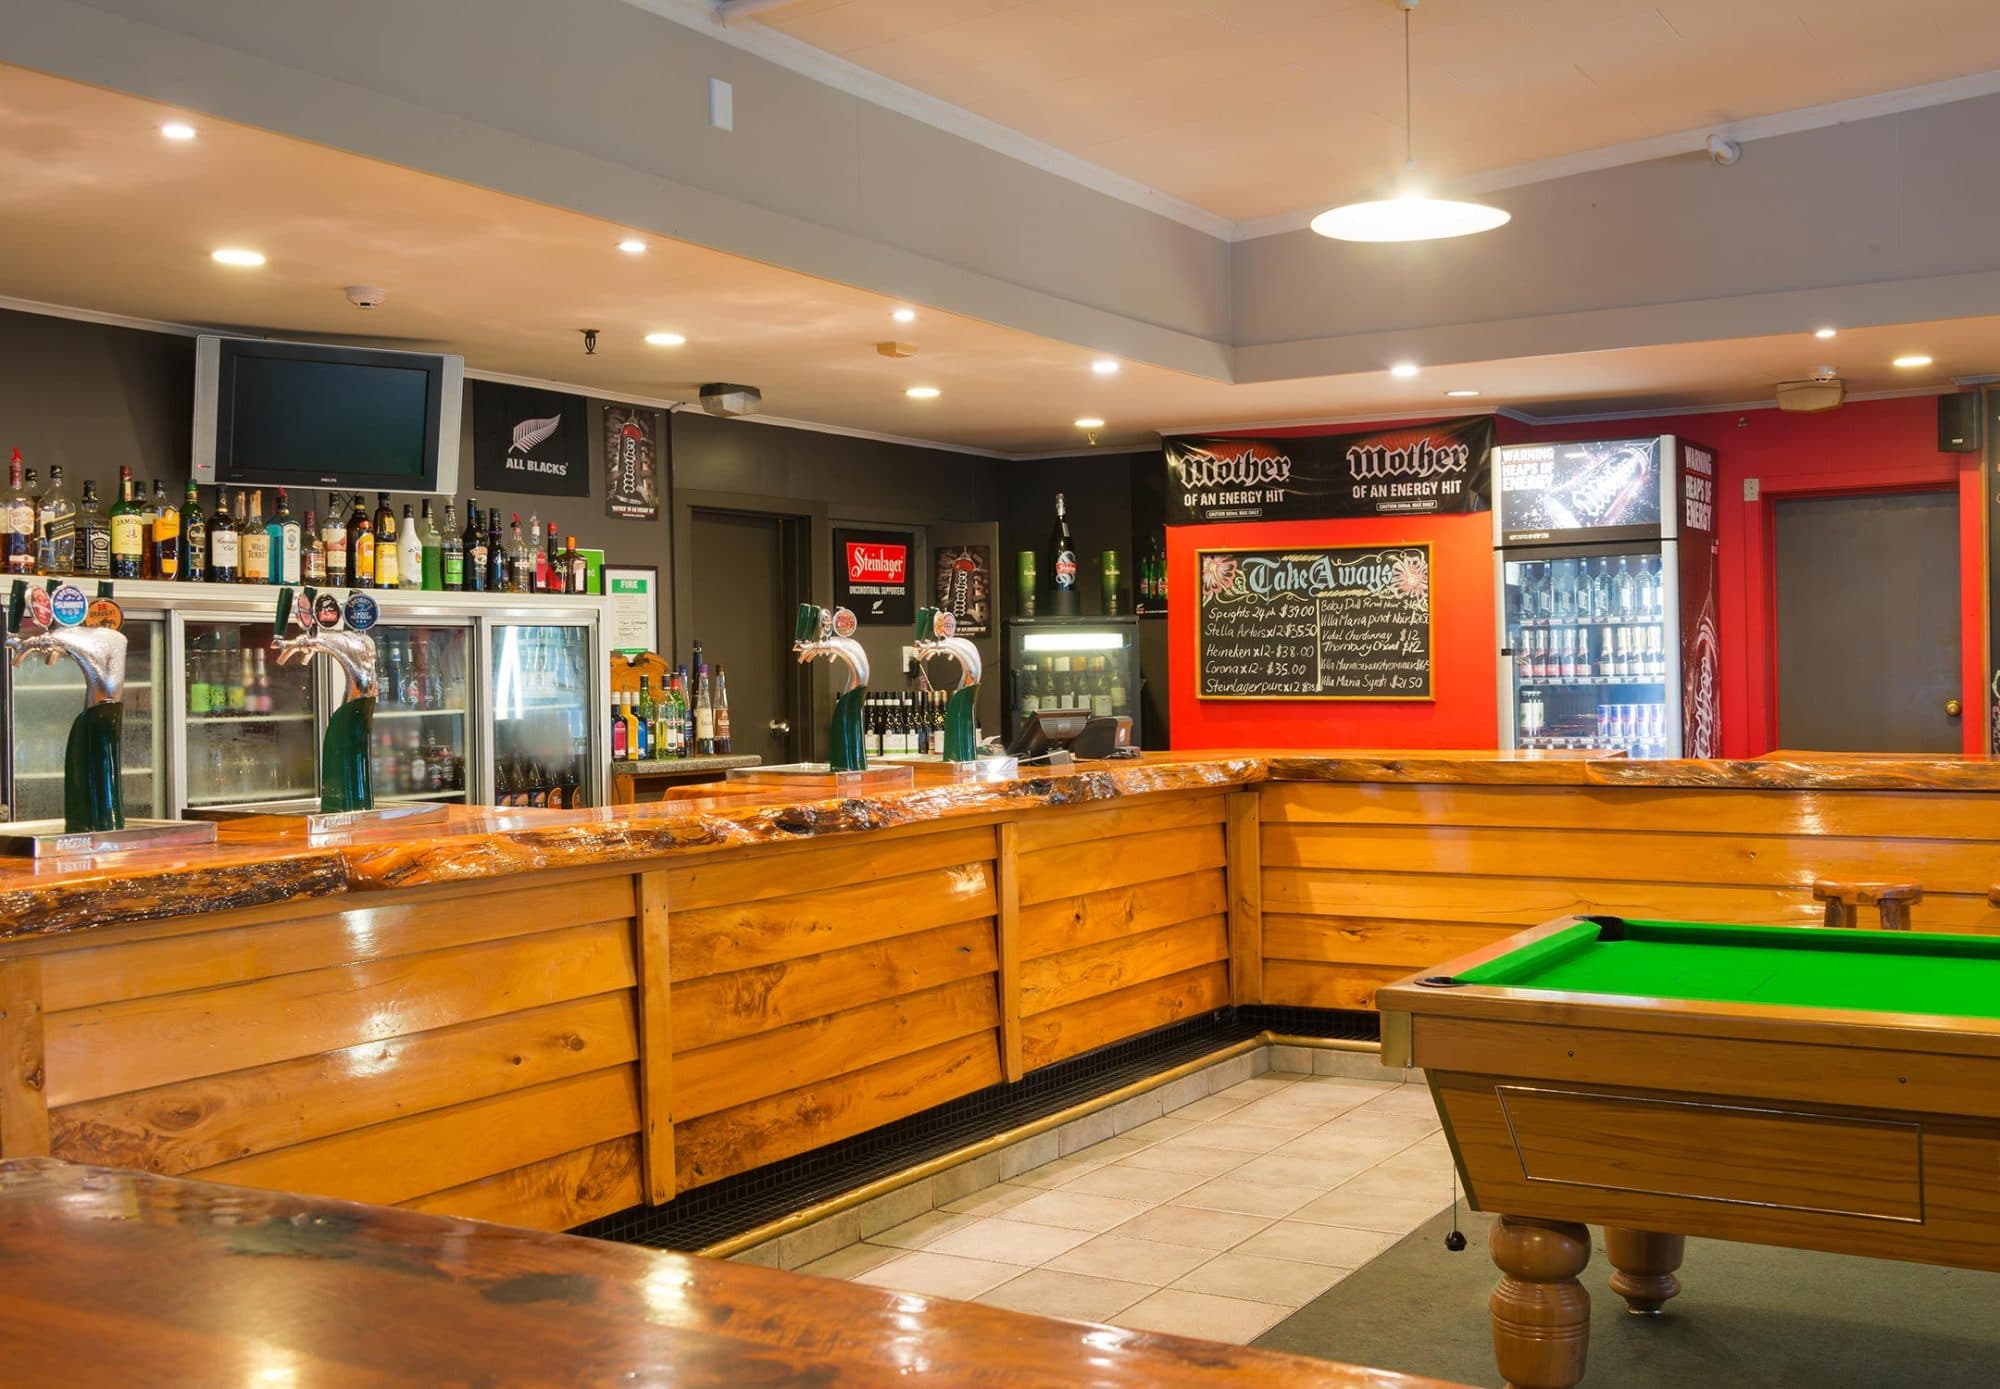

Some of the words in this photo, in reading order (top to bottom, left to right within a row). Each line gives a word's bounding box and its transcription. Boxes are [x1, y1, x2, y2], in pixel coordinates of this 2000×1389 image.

[506, 458, 525, 471] ALL
[527, 460, 567, 476] BLACKS
[1353, 485, 1367, 498] OF
[1370, 484, 1387, 497] AN
[1391, 481, 1438, 496] ENERGY
[1442, 480, 1461, 493] HIT
[1184, 493, 1198, 507] OF
[1200, 492, 1216, 506] AN
[1219, 490, 1262, 505] ENERGY
[1266, 489, 1285, 502] HIT
[851, 547, 903, 580] Steinlager
[620, 580, 638, 589] FIRE
[1205, 623, 1234, 638] Stella
[1206, 643, 1251, 658] Heineken
[1205, 660, 1238, 674] Corona
